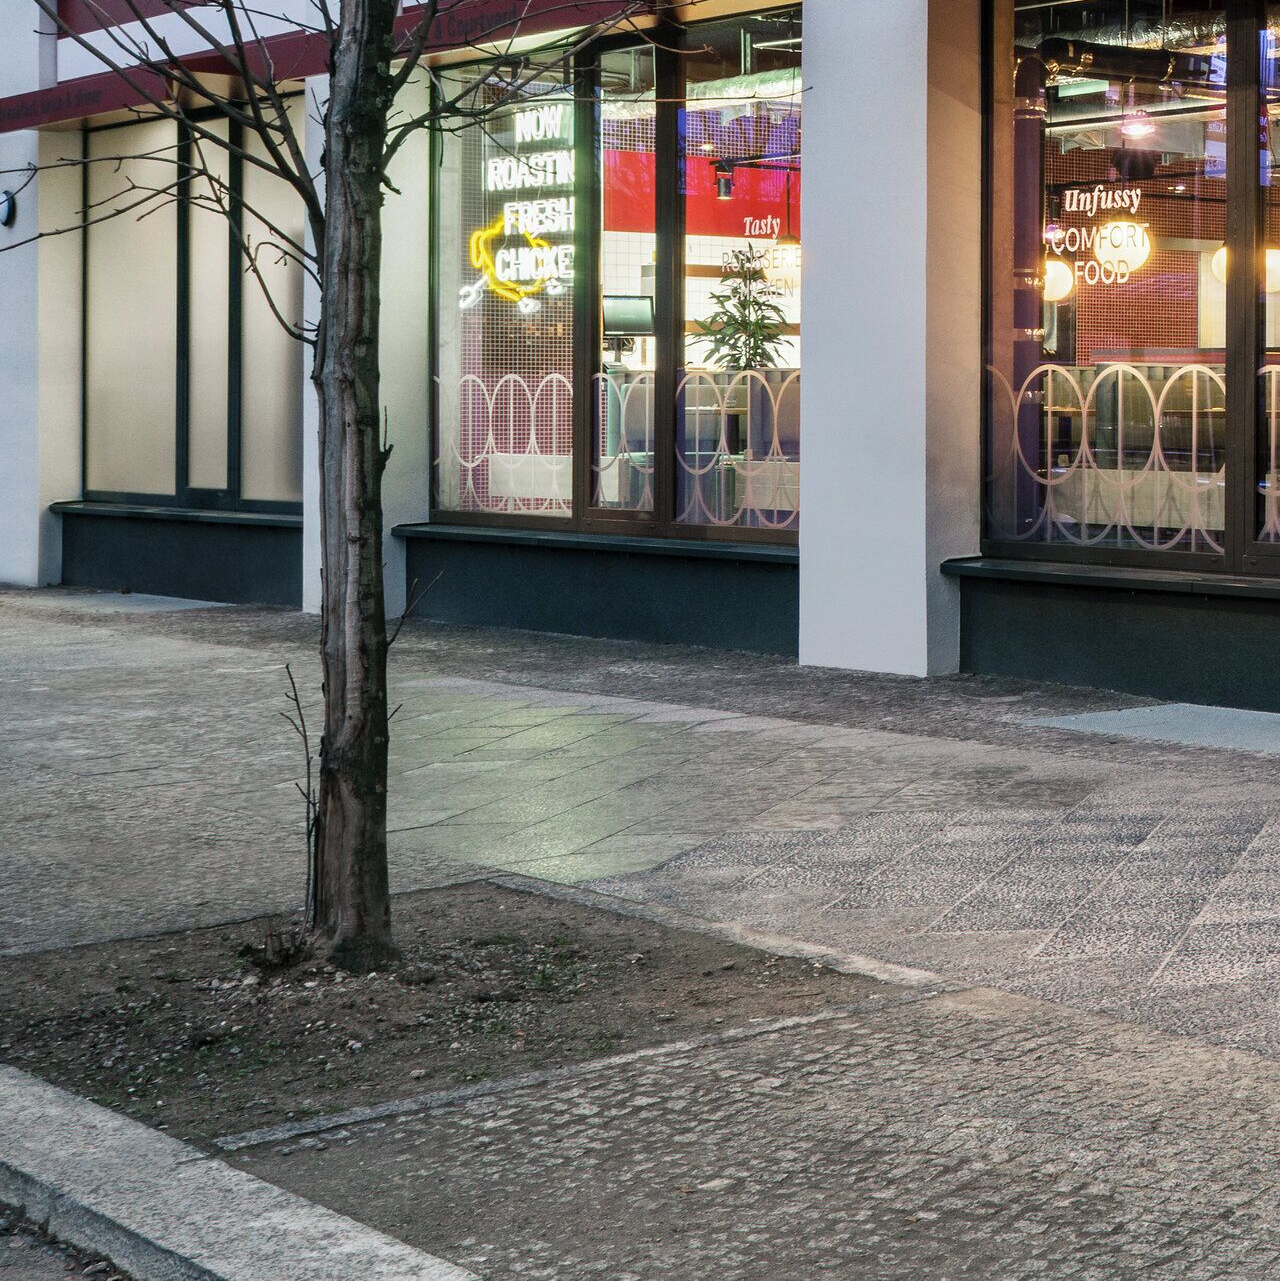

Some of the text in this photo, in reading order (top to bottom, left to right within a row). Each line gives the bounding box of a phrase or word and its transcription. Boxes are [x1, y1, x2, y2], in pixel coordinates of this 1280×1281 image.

[515, 104, 564, 143] NOW
[488, 149, 575, 191] ROASTIN
[504, 196, 575, 236] FRESH
[1065, 184, 1142, 217] Unfussy
[744, 215, 780, 239] Tasty
[1052, 223, 1150, 254] COMFORT
[495, 245, 575, 282] CHICKE
[721, 247, 801, 273] ROTISSERIE
[1075, 260, 1130, 285] FOOD
[730, 278, 794, 301] CHICKEN
